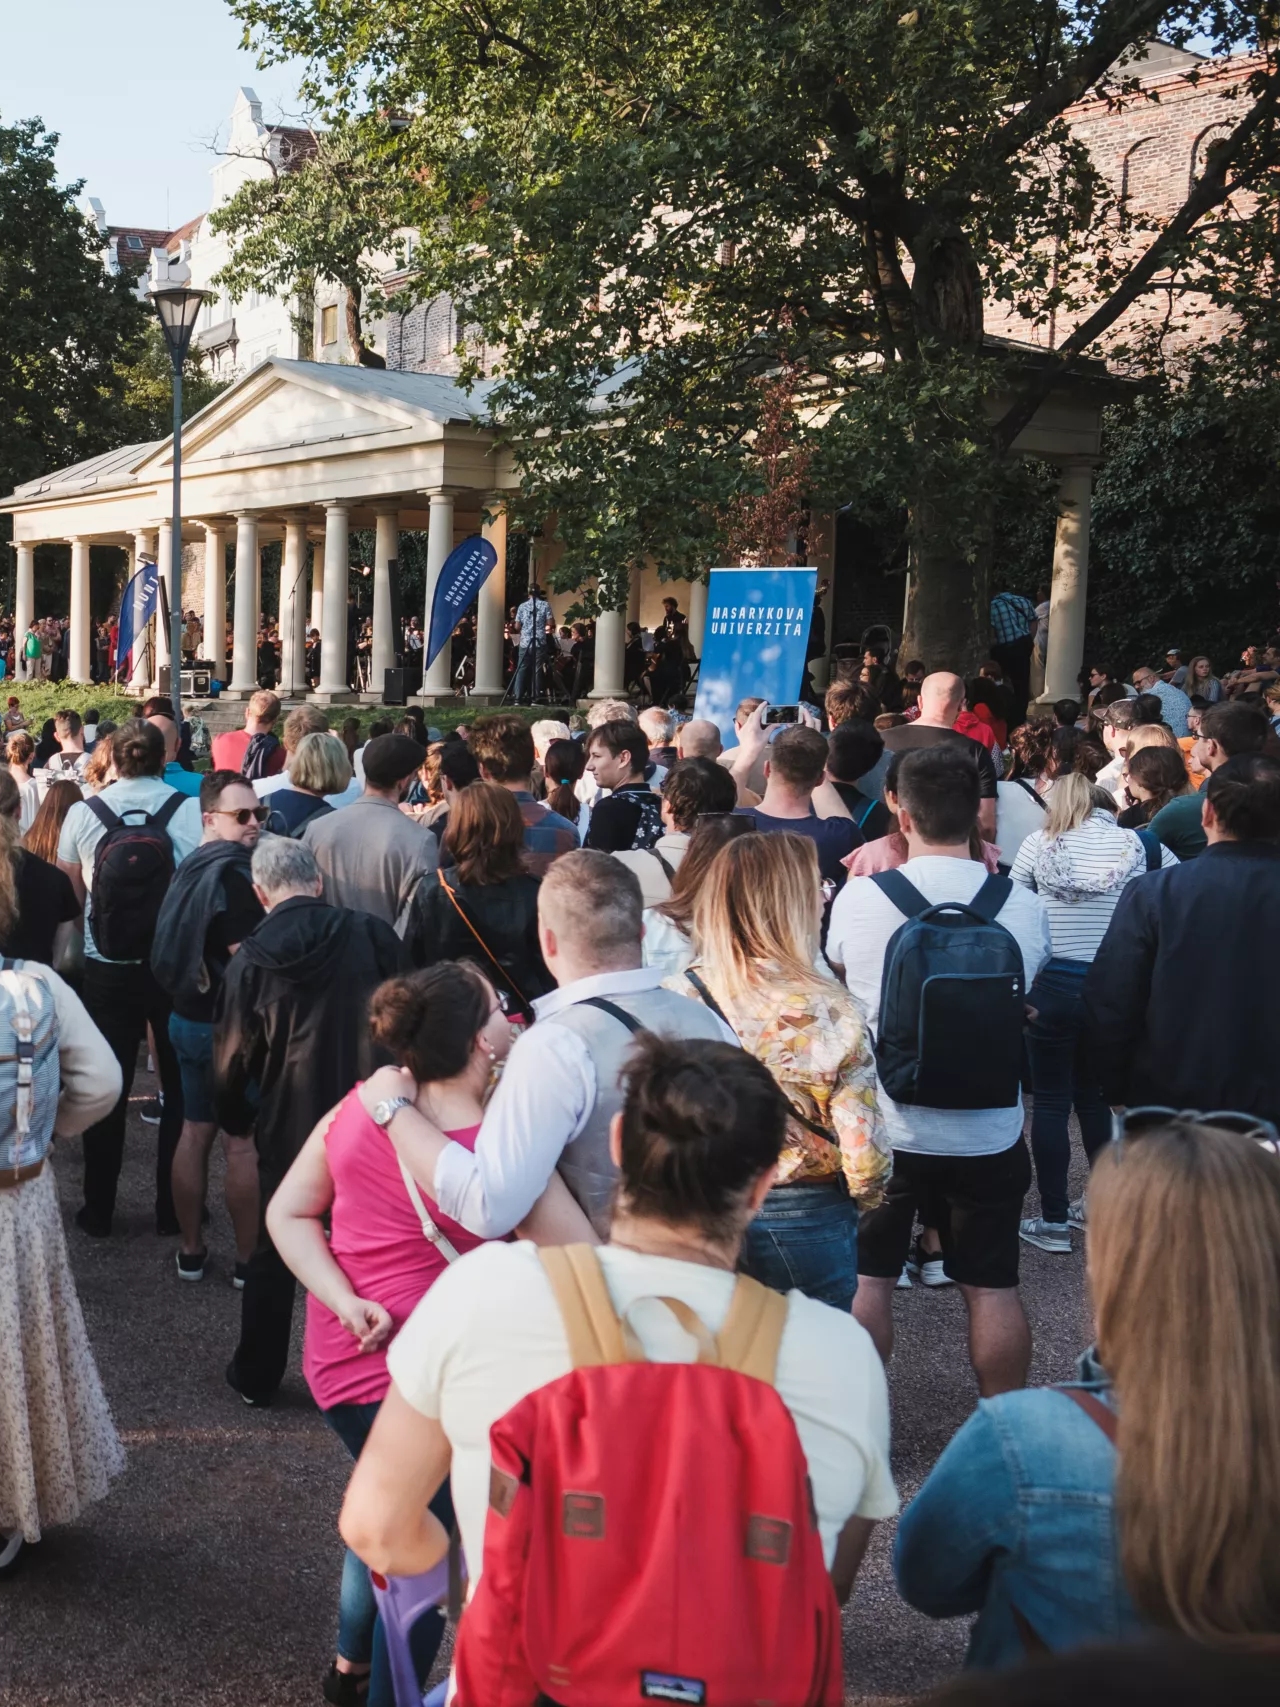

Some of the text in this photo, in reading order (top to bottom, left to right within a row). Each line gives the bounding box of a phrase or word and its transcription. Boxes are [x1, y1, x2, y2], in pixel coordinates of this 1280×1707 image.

[444, 550, 480, 602] MASARYKOVA
[452, 555, 488, 607] UNIVERZITA
[711, 622, 801, 636] UNIVERZITA
[712, 607, 803, 621] MASARYKOVA
